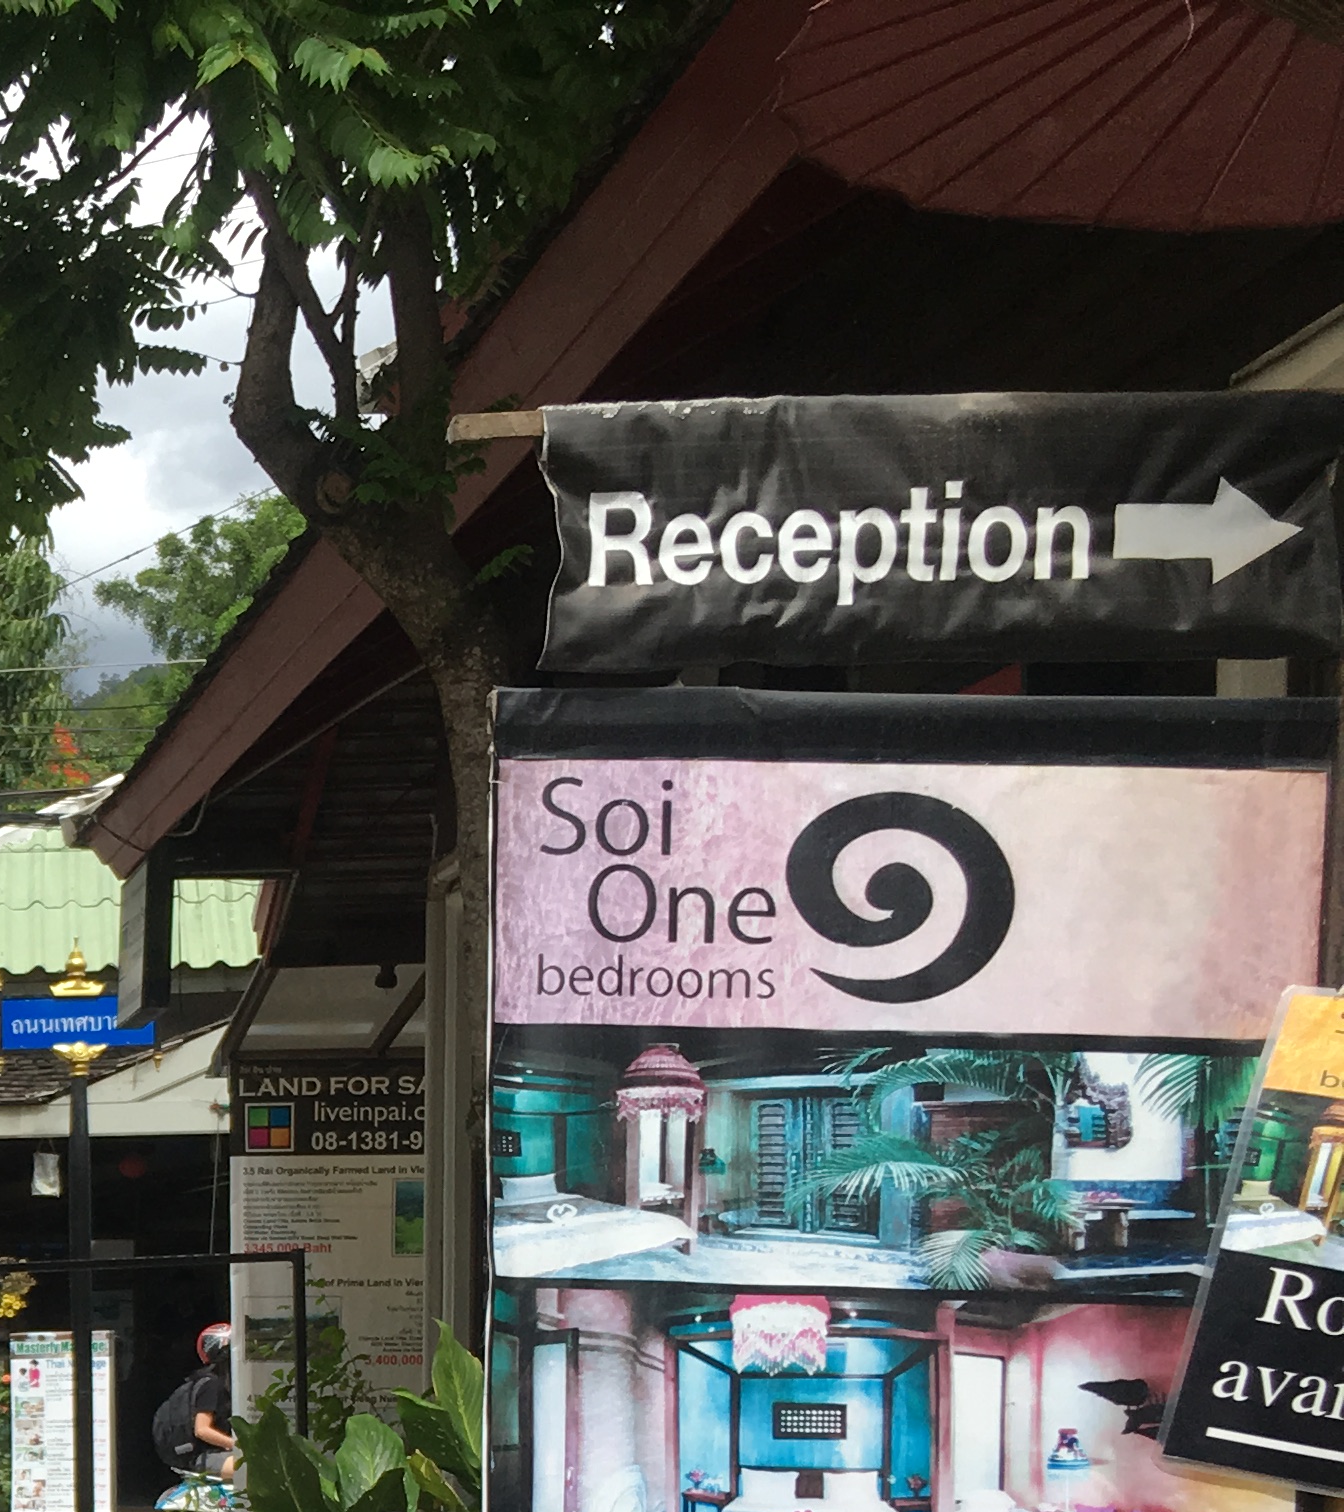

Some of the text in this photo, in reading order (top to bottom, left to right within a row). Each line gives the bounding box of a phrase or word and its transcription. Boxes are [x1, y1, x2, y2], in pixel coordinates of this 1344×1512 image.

[588, 480, 1091, 606] Reception
[540, 776, 673, 855] Soi
[588, 863, 776, 944] One
[537, 953, 776, 999] bedrooms
[239, 1077, 322, 1097] LAND
[330, 1076, 390, 1096] FOR
[276, 1166, 330, 1176] Organically
[332, 1166, 370, 1175] Farmed
[372, 1165, 396, 1174] Land
[398, 1165, 408, 1174] in
[337, 1279, 364, 1287] Prime
[367, 1279, 392, 1287] Land
[16, 1342, 59, 1354] Masterly
